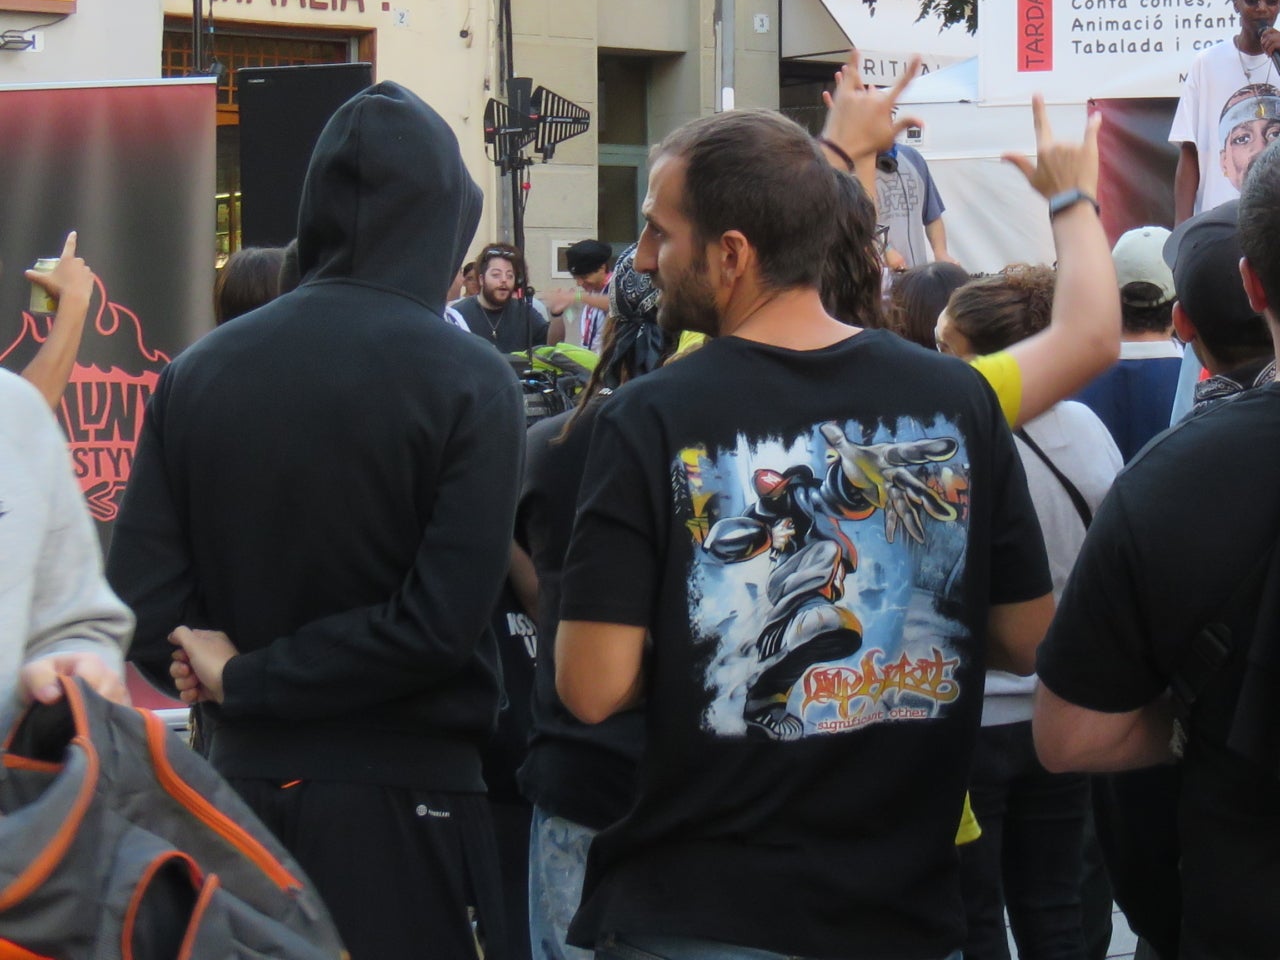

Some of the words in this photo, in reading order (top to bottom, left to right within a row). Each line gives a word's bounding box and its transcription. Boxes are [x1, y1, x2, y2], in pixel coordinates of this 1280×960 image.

[1071, 14, 1163, 32] Animació
[1072, 37, 1164, 55] Tabalada
[817, 711, 884, 732] significant
[890, 707, 927, 719] other
